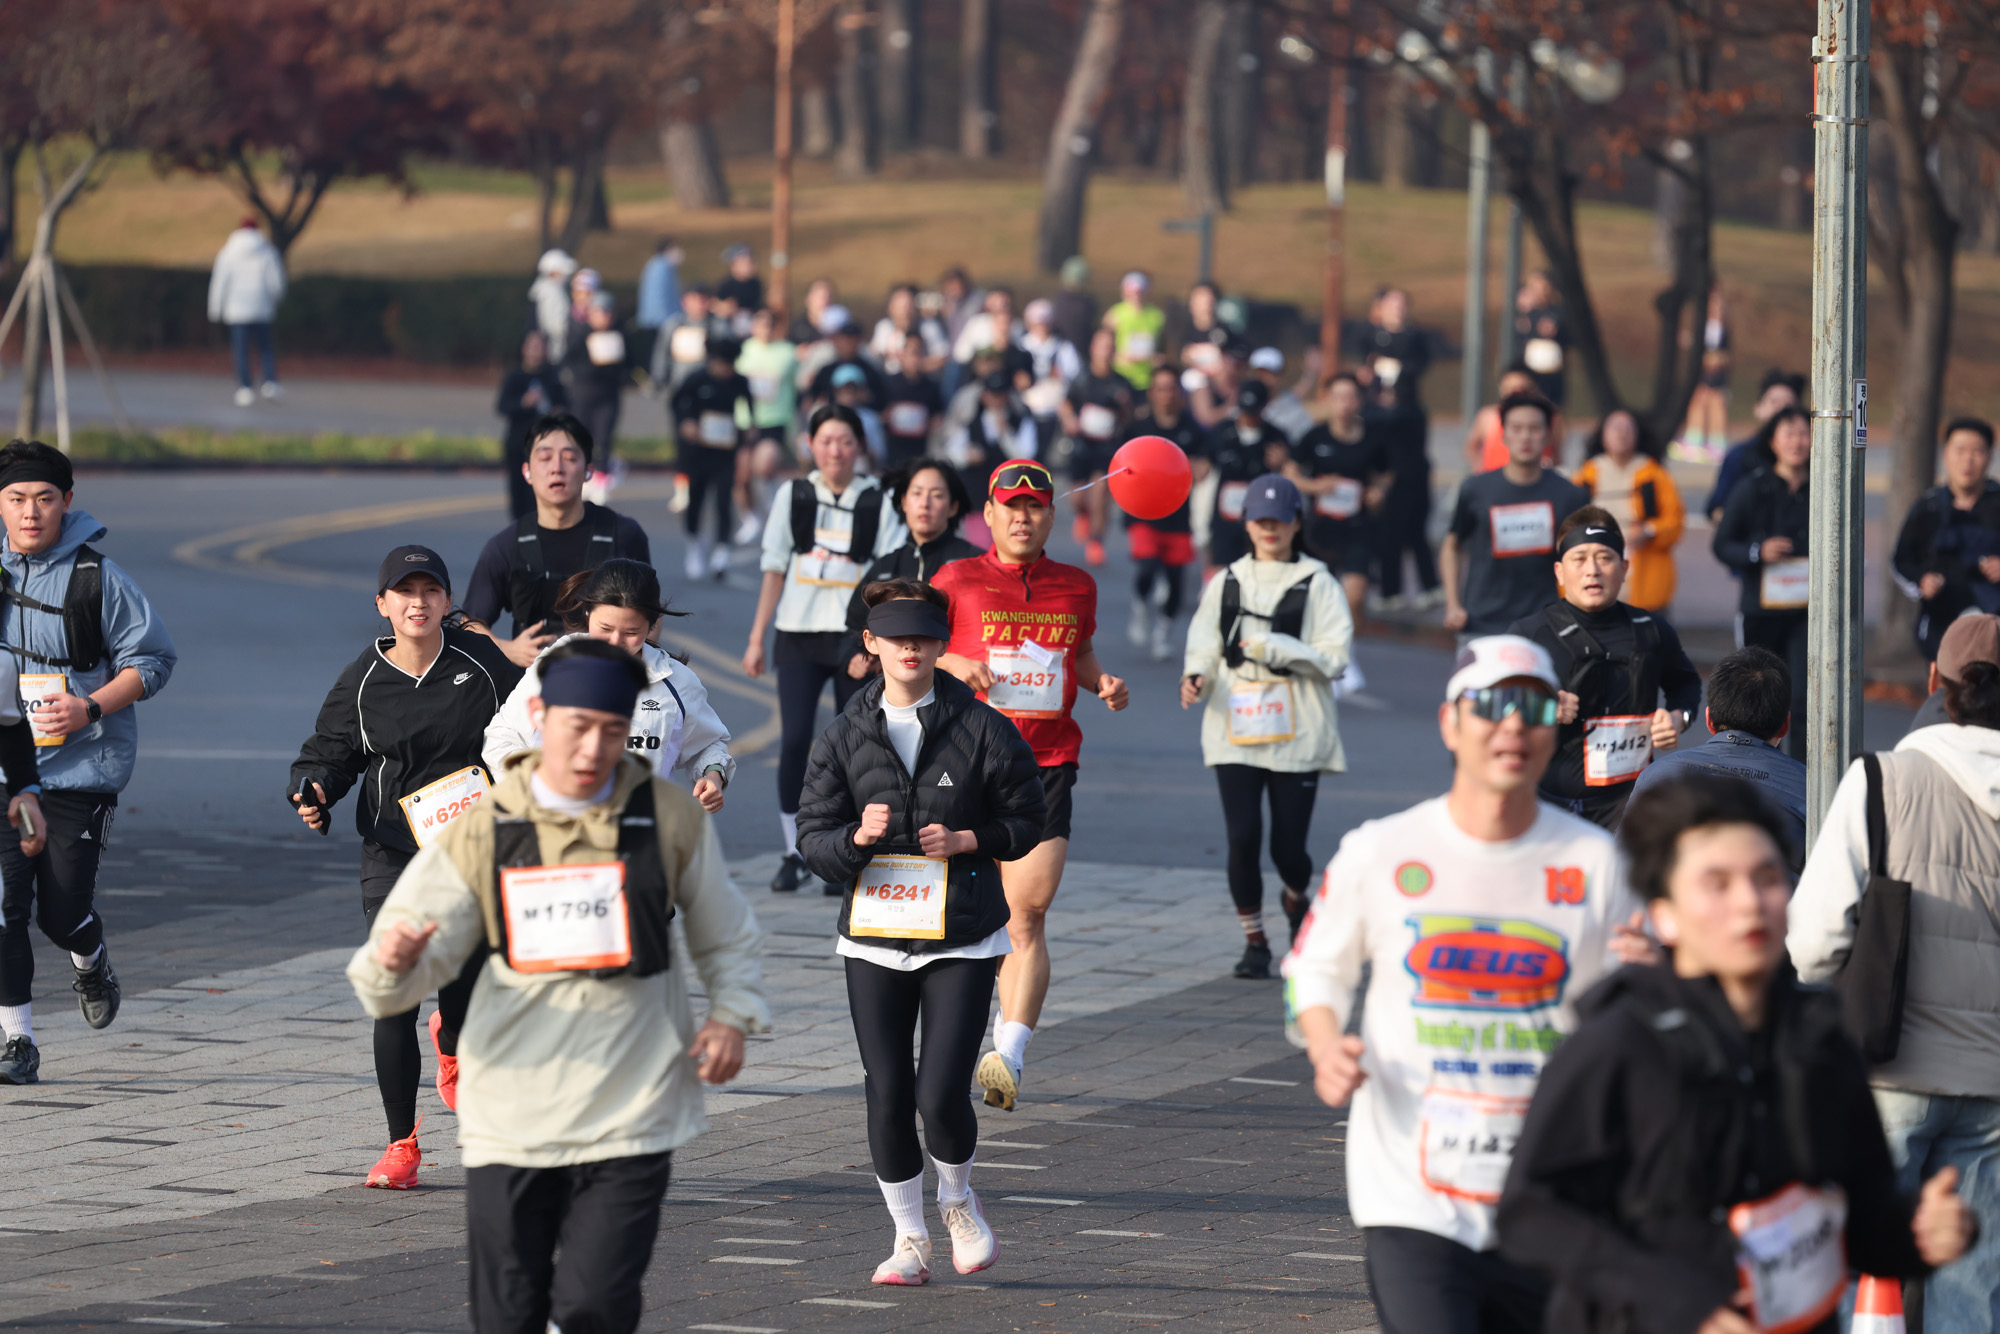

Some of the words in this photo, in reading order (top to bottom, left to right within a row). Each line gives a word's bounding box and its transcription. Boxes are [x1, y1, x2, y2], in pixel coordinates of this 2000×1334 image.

[981, 611, 1078, 625] KWANGHWAMUN
[981, 625, 1078, 644] PACING
[904, 862, 929, 870] STORY
[866, 883, 931, 902] W6241
[1544, 866, 1588, 906] 19
[1428, 945, 1548, 979] DEUS
